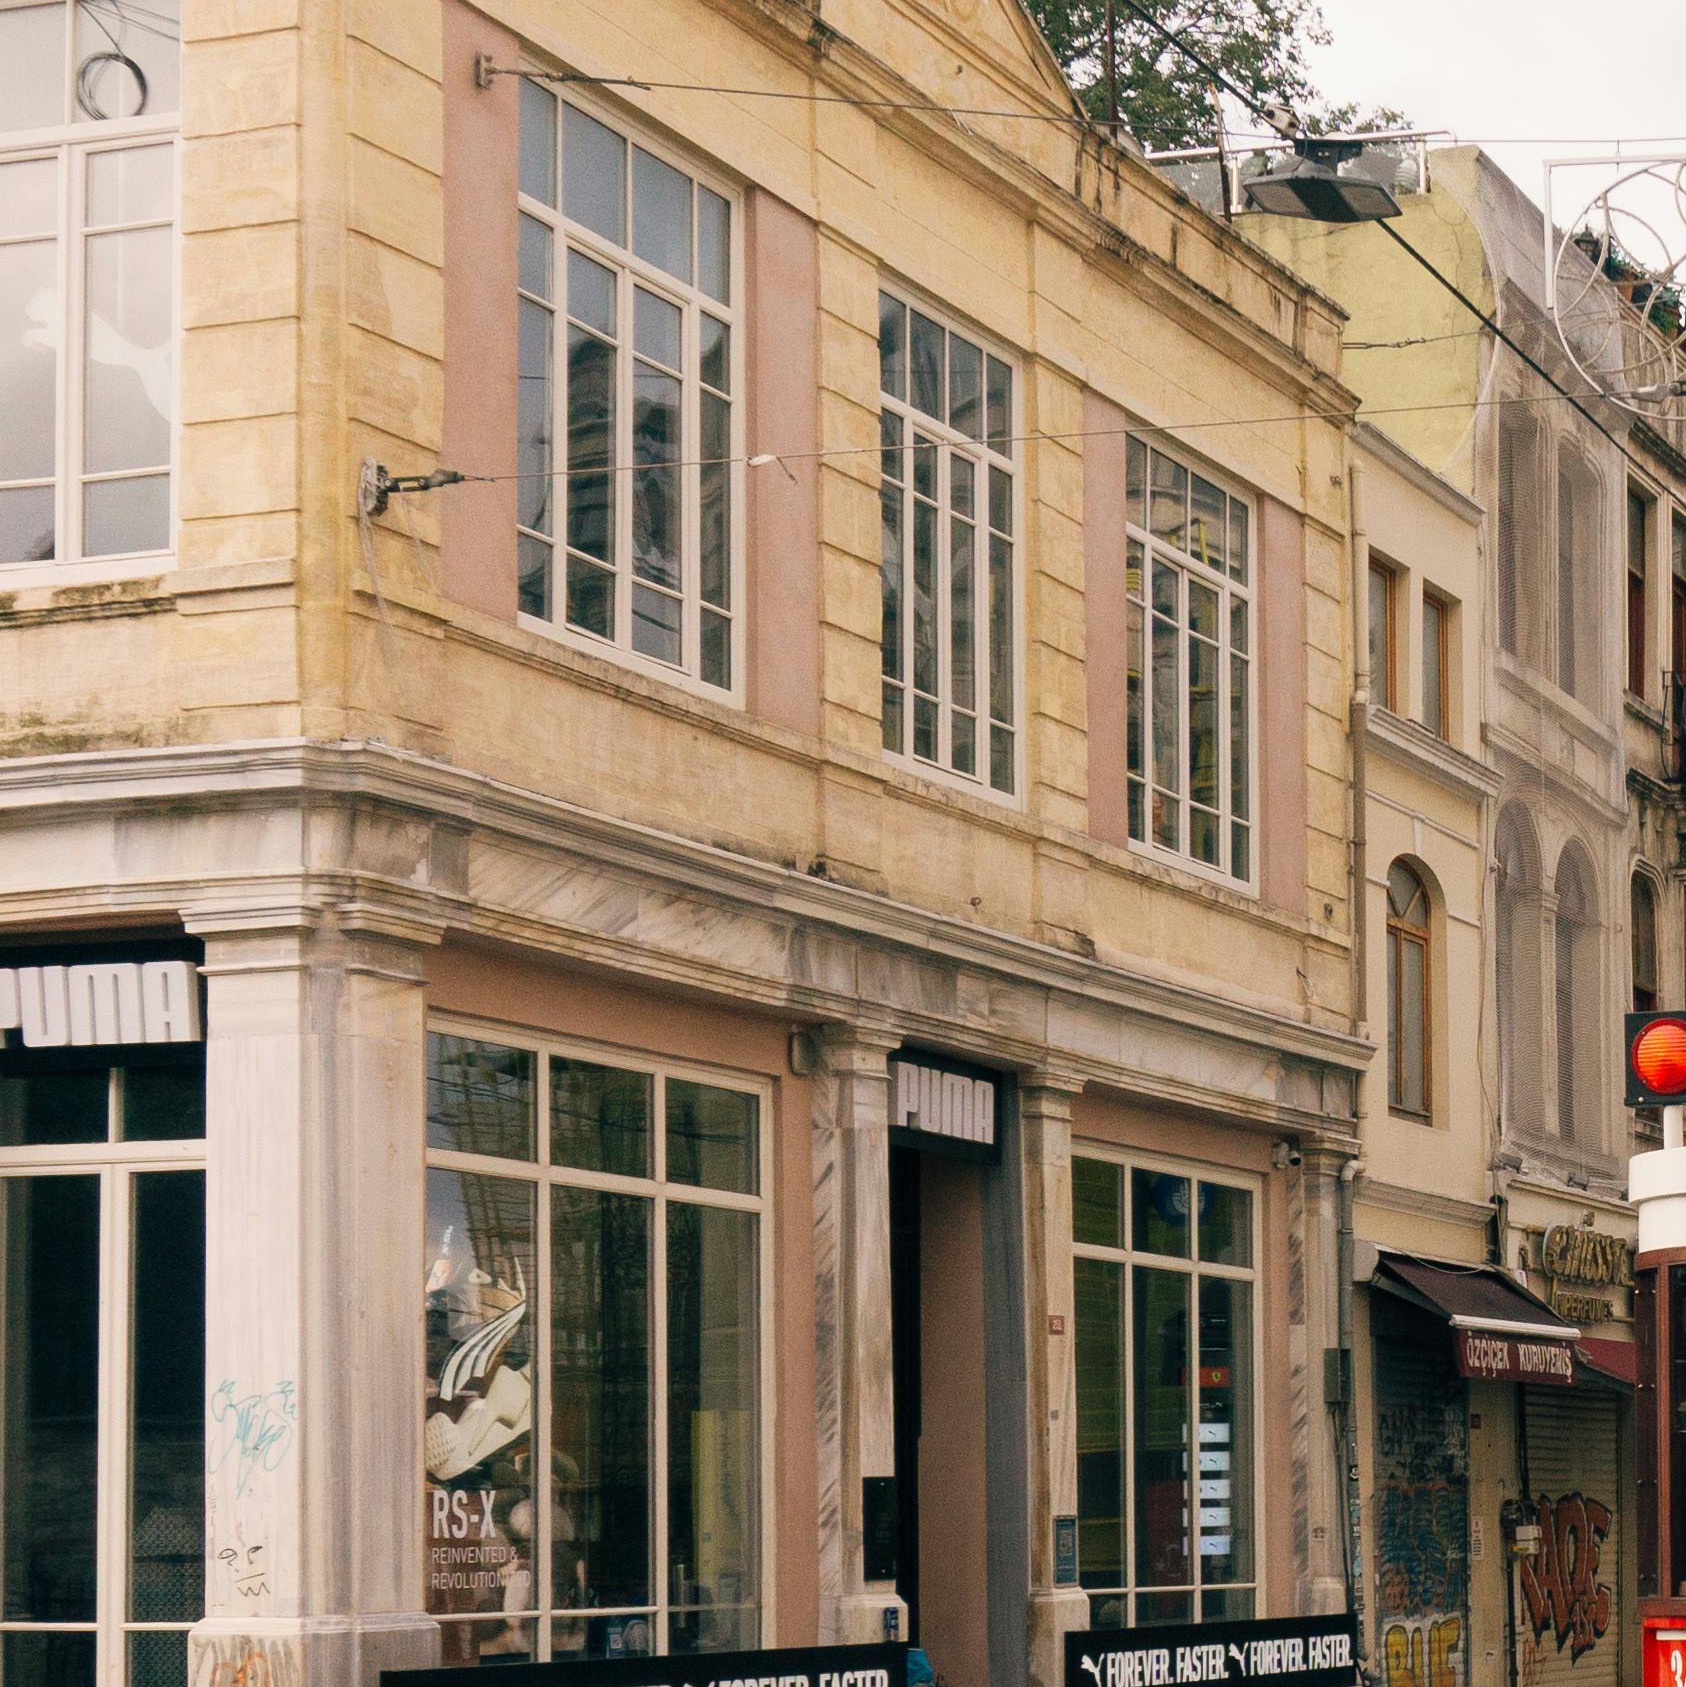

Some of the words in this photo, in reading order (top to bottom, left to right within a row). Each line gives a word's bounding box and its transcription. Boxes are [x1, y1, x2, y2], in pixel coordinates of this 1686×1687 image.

[897, 1061, 994, 1145] PUMA
[1466, 1330, 1510, 1377] ÖZÇİÇEK
[1517, 1341, 1572, 1383] KURUYEMİŞ
[433, 1489, 496, 1539] RS-X
[432, 1546, 506, 1565] REINVENTED
[510, 1546, 519, 1563] &
[1176, 1644, 1229, 1683] FASTER.
[1250, 1638, 1307, 1676] FOREVER.
[1308, 1634, 1353, 1670] FASTER.
